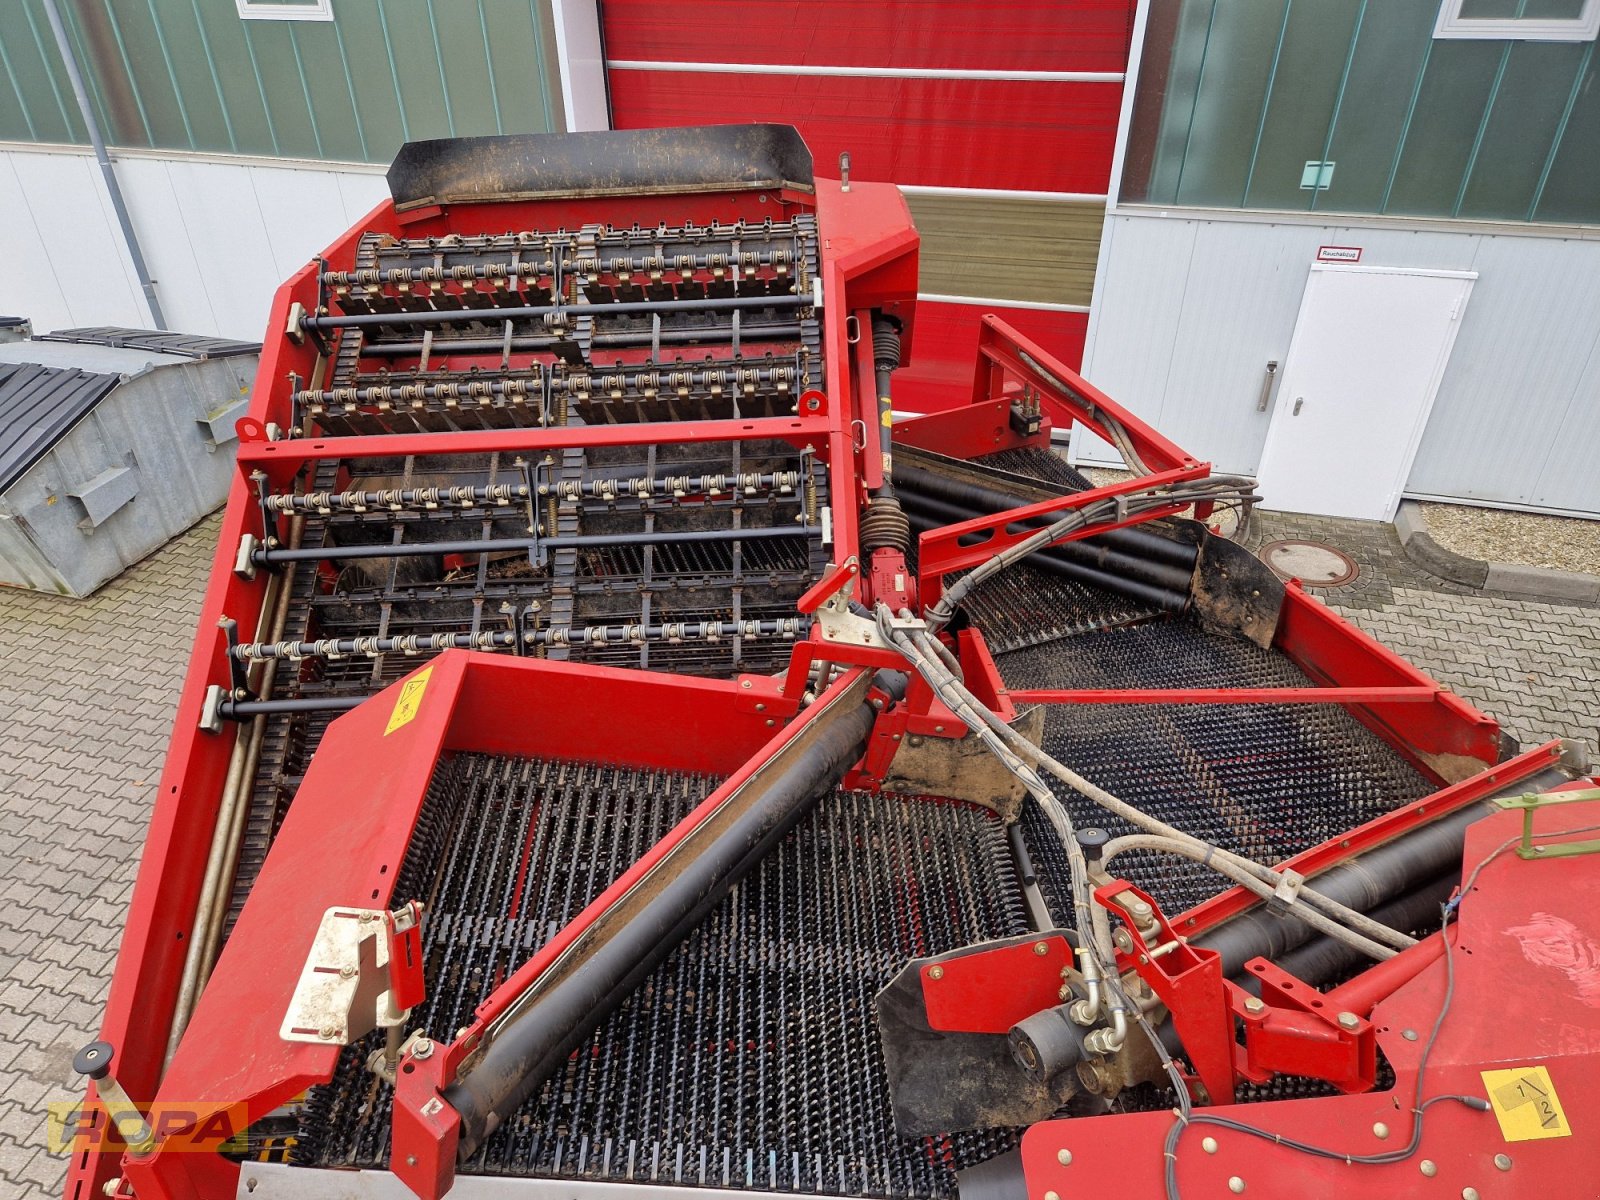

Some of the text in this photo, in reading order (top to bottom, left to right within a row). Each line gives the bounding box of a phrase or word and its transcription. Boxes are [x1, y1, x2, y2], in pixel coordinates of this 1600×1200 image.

[1322, 250, 1356, 258] Rauchabzug
[1516, 1085, 1525, 1097] 1
[1541, 1101, 1553, 1114] 2
